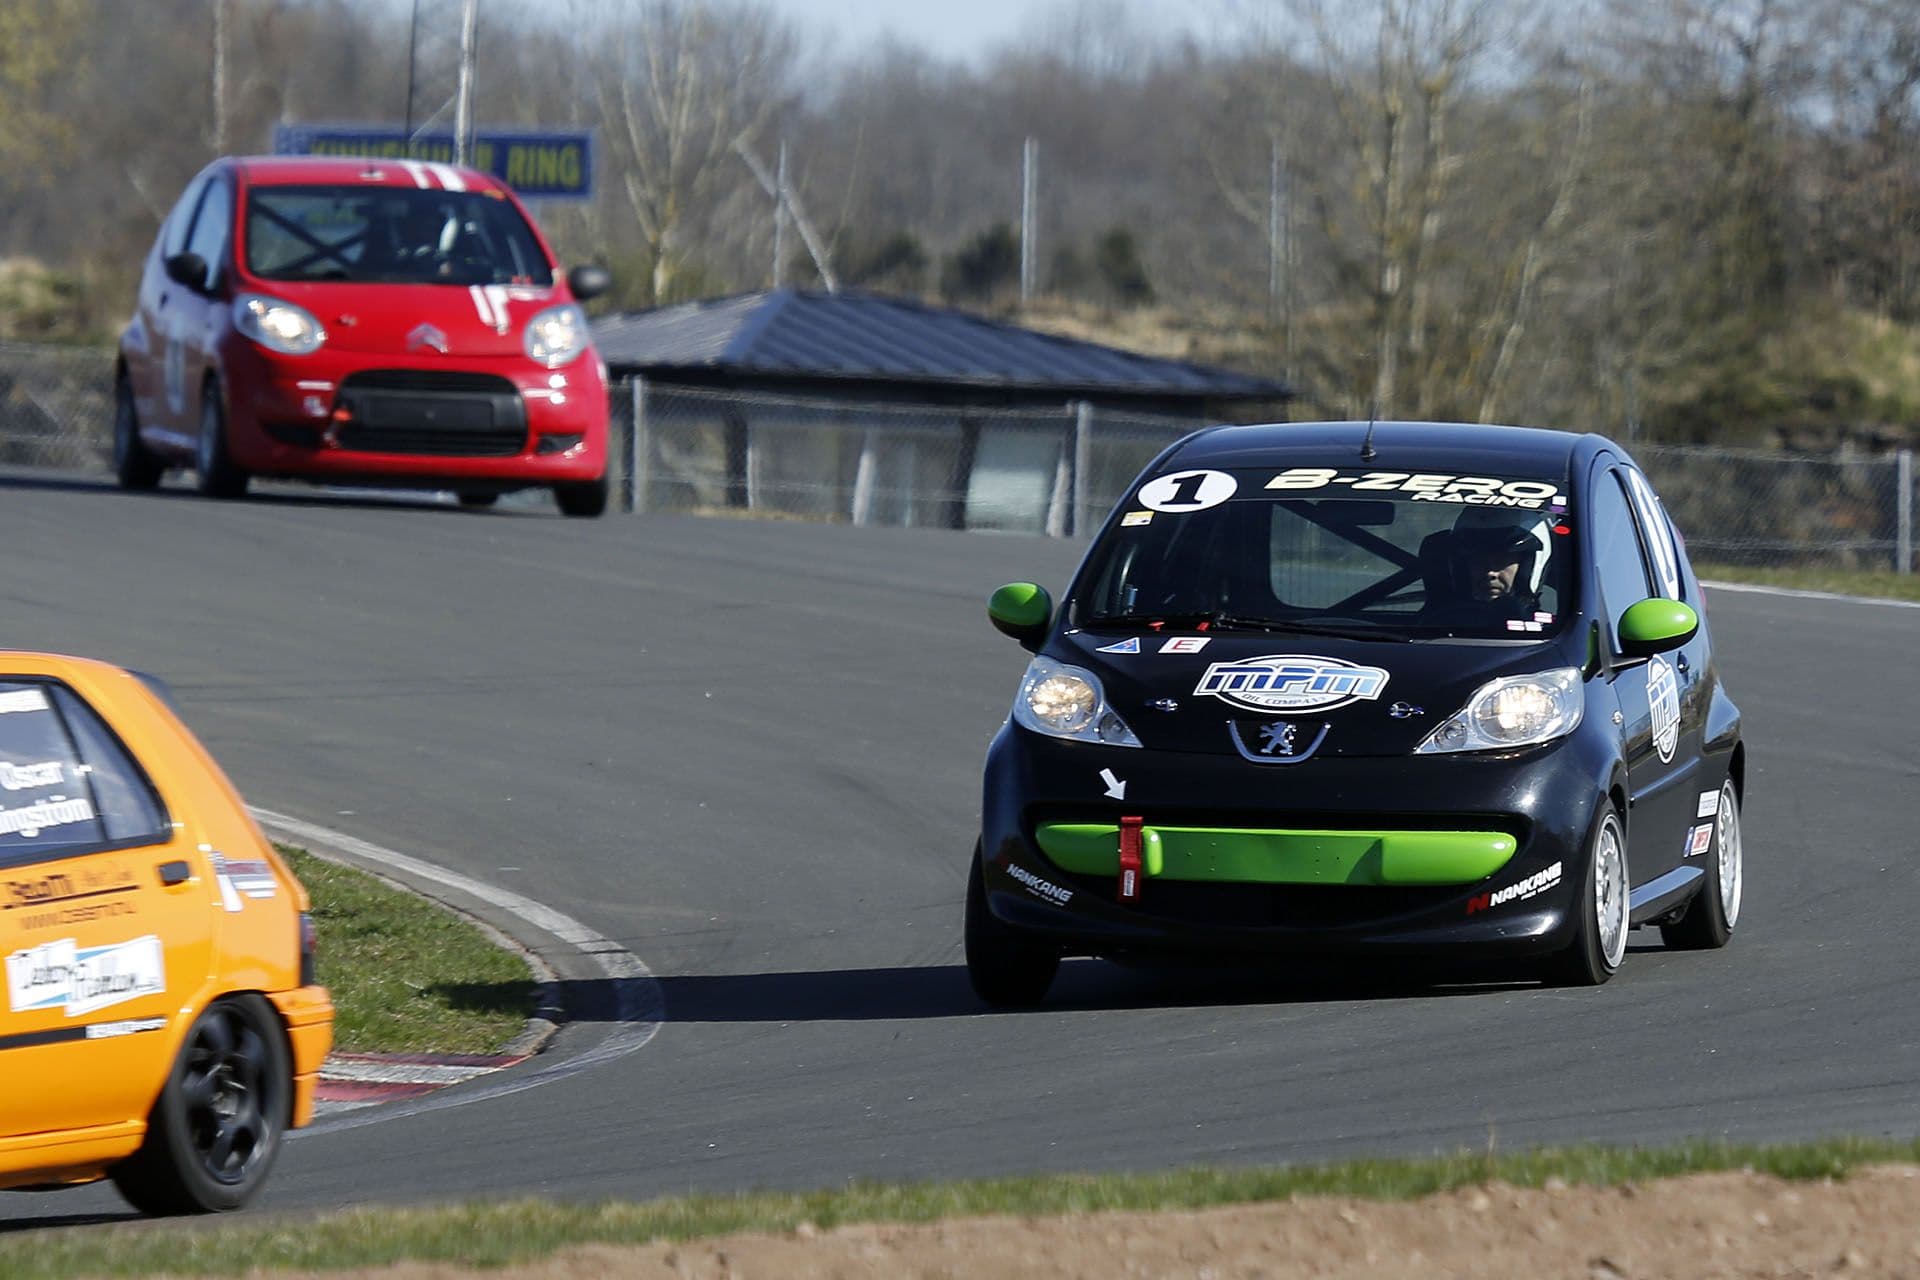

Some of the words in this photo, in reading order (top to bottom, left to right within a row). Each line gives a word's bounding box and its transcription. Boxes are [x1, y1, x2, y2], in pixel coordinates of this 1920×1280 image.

[508, 144, 581, 187] RING
[1160, 473, 1208, 505] 1
[1264, 468, 1558, 499] B-ZERO
[1411, 491, 1545, 509] RACING
[1242, 693, 1261, 702] OIL
[1006, 863, 1074, 902] NANKANG
[1490, 861, 1562, 906] NANKANG
